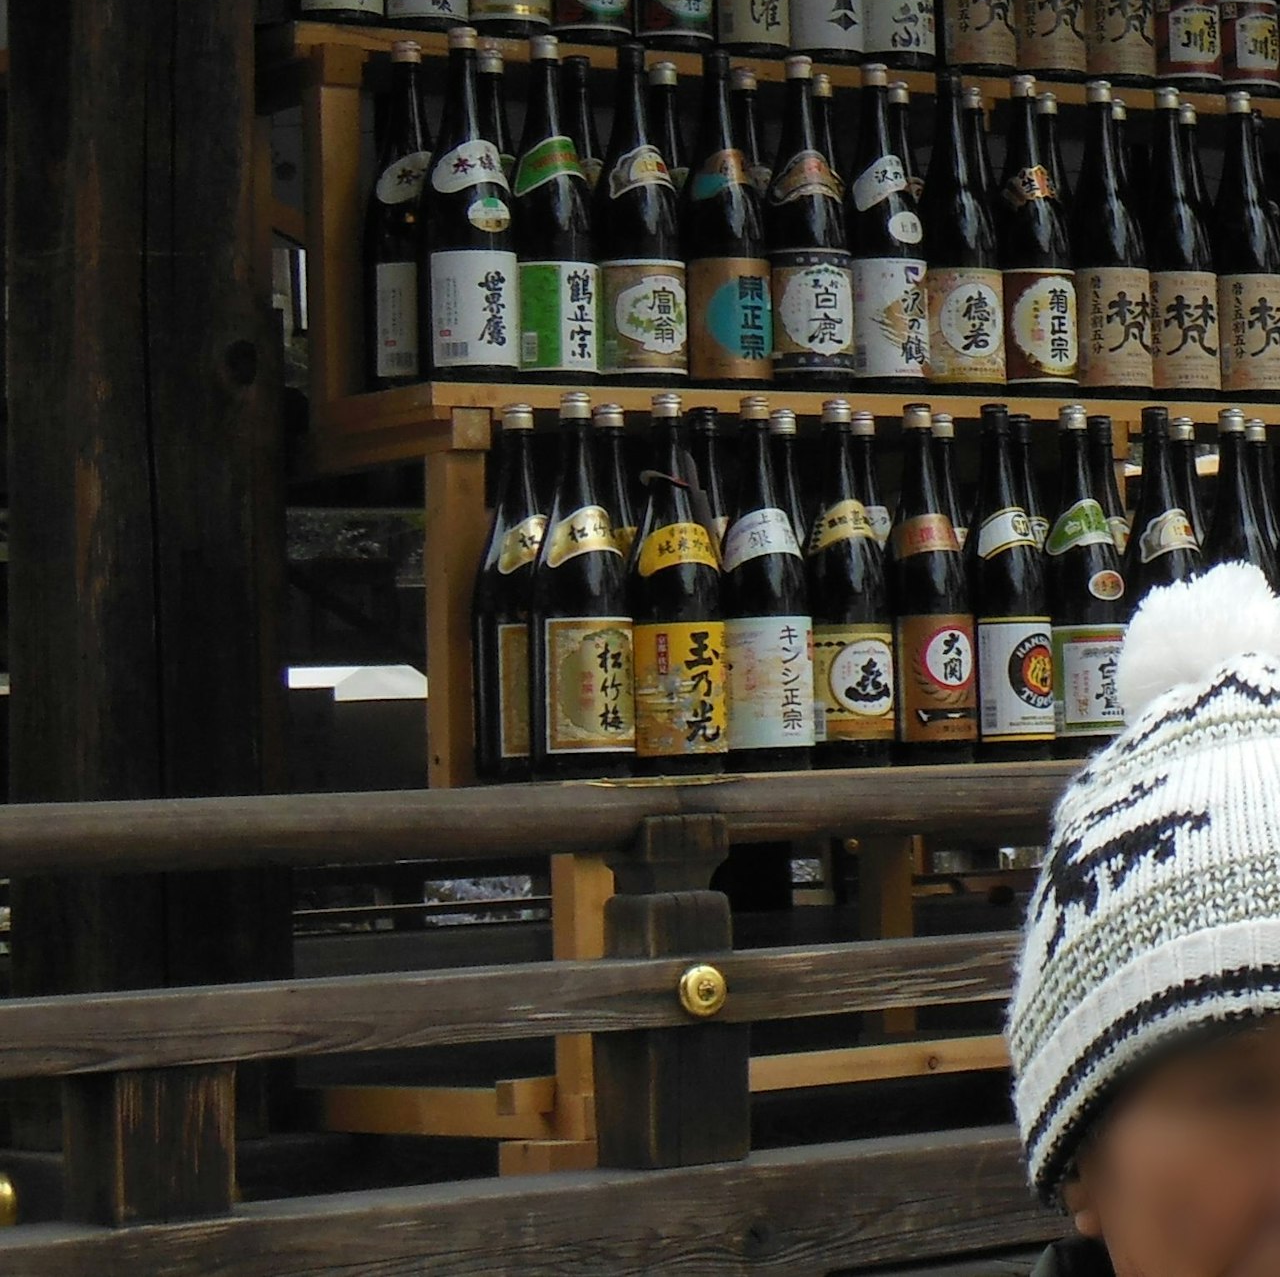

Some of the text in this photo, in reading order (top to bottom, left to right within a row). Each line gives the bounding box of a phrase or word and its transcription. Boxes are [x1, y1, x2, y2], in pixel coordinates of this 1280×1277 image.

[566, 269, 596, 360] 鶴正宗
[648, 286, 677, 345] 富翁
[808, 287, 843, 345] 白鹿
[901, 289, 930, 365] 沢の鶴
[1048, 287, 1071, 363] 菊正宗
[597, 640, 624, 731] 松竹梅
[684, 631, 720, 743] 玉乃光
[779, 623, 804, 731] キンシ正宗
